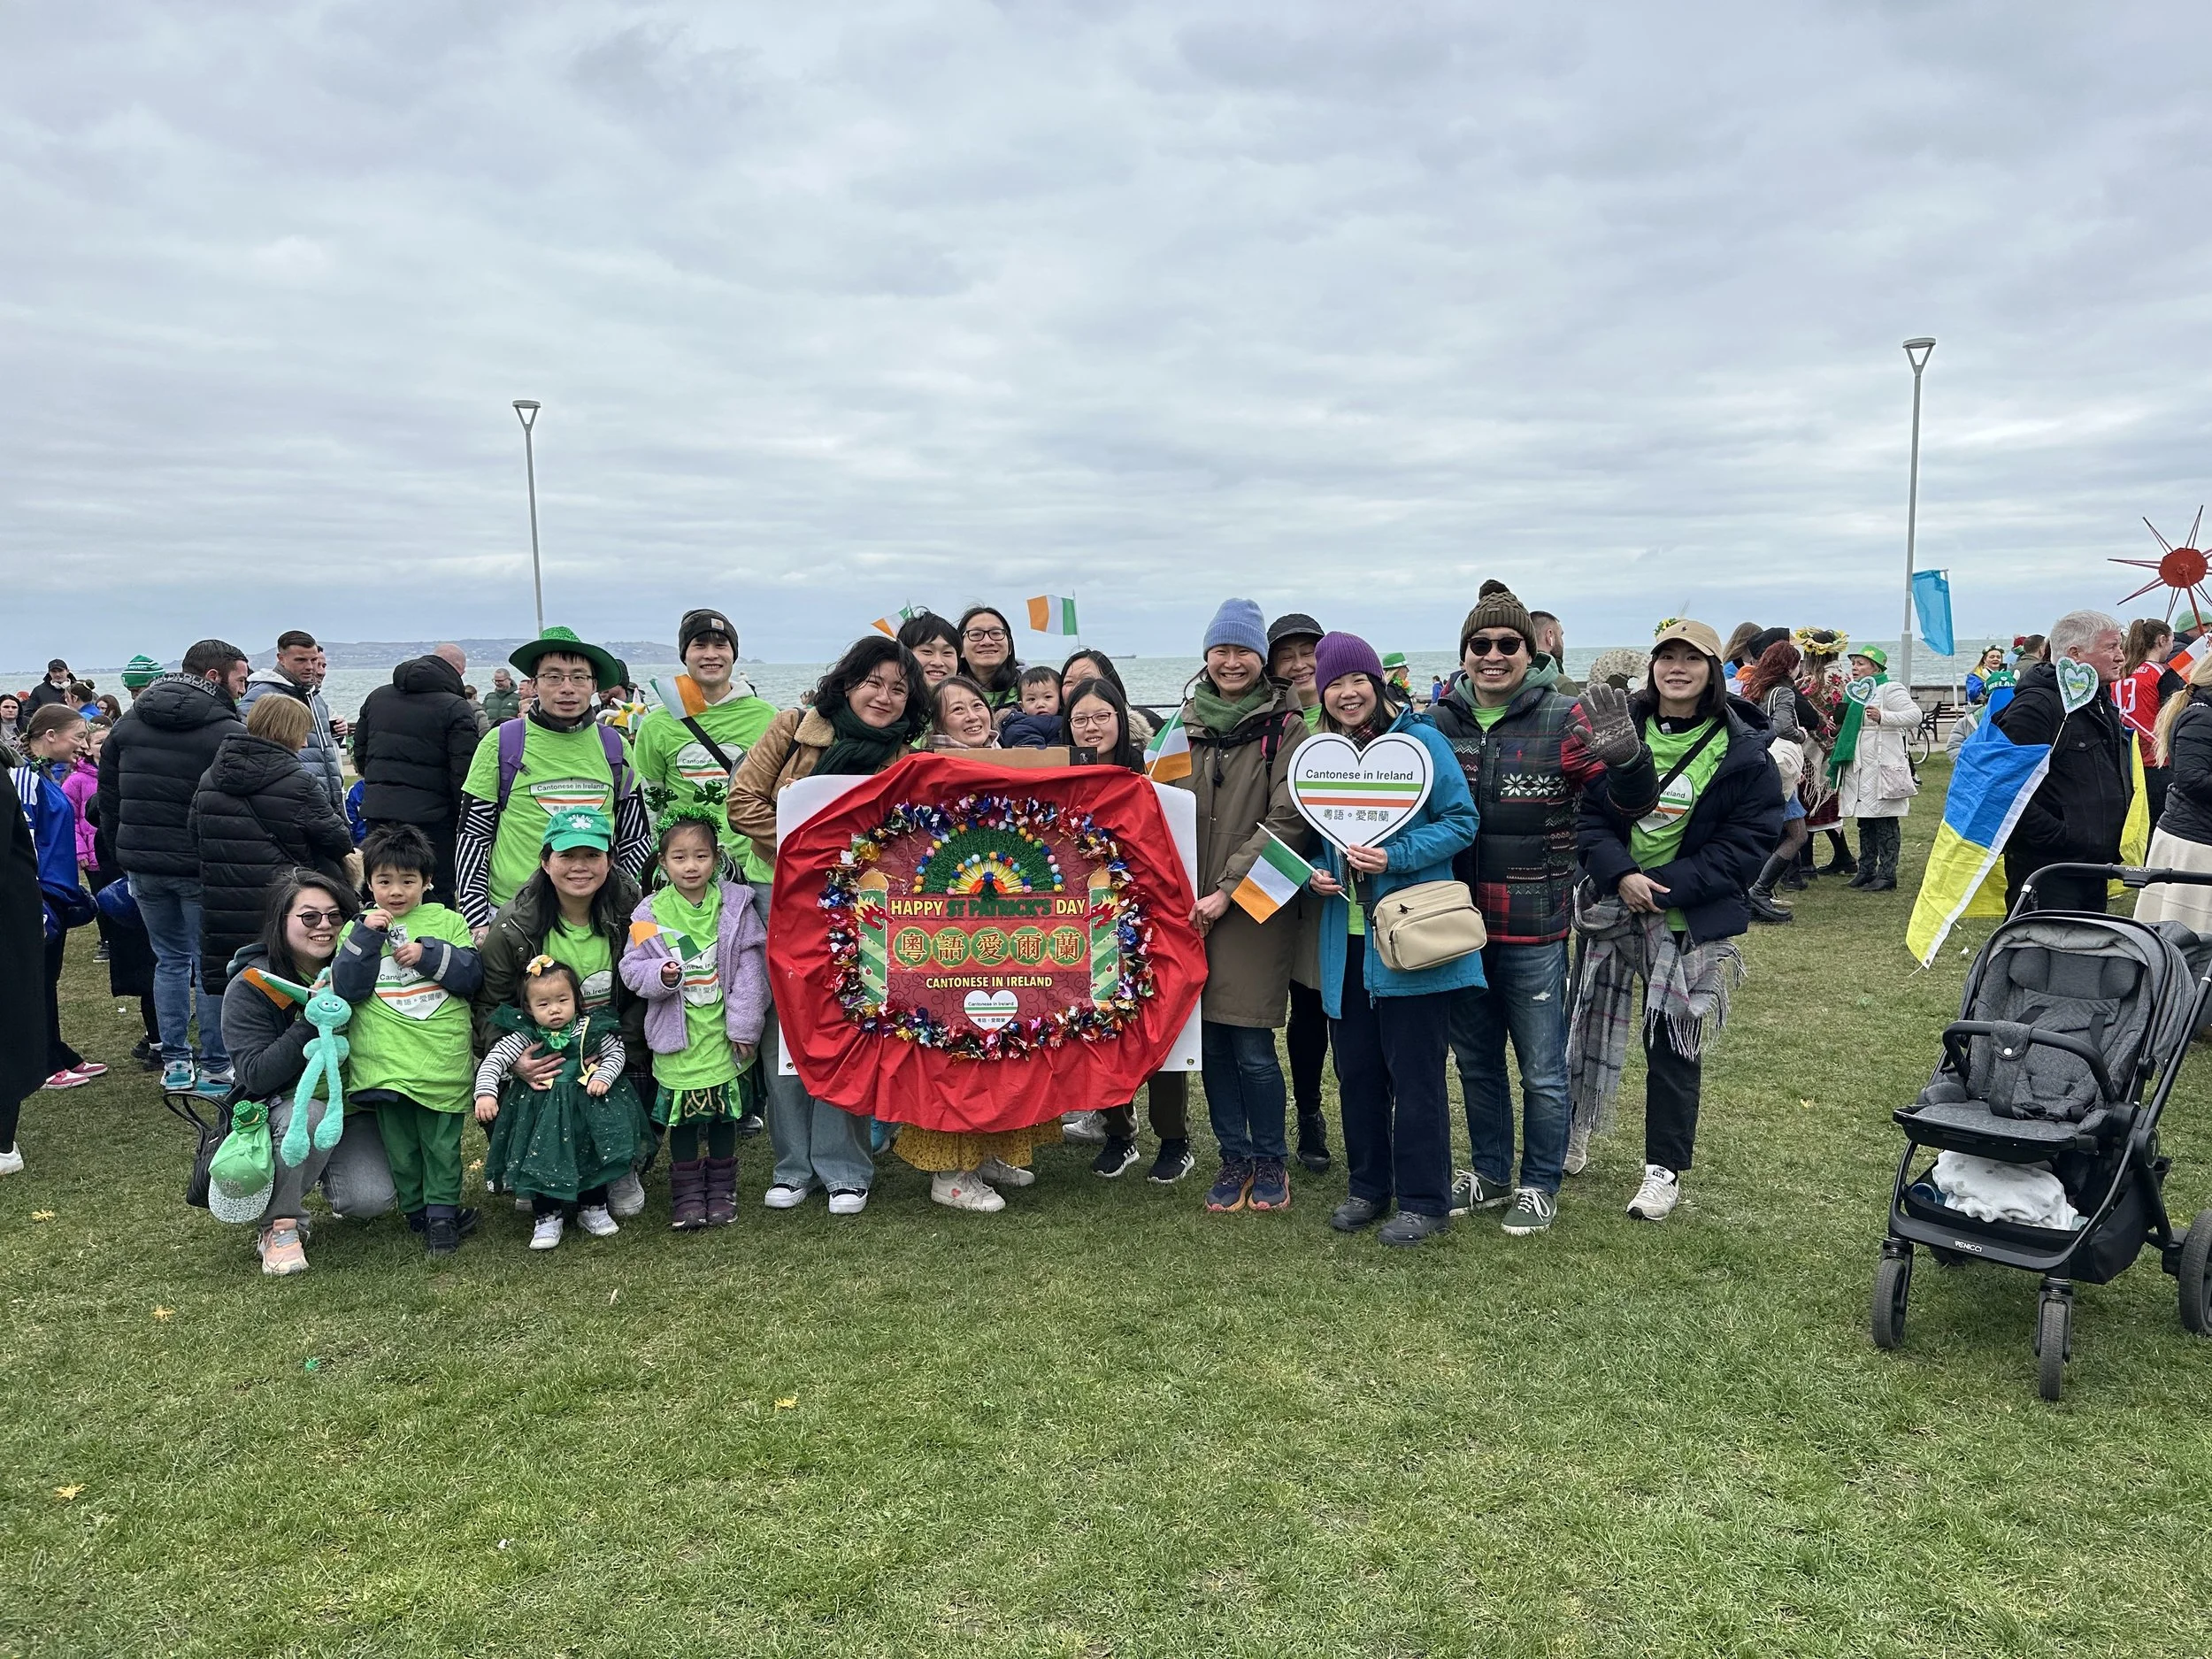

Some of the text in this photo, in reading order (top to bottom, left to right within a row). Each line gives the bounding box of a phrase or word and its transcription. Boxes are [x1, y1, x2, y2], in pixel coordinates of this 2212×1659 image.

[1306, 769, 1414, 780] Cantonese in Ireland
[537, 783, 574, 792] Cantonese
[566, 814, 594, 824] IRELAND
[890, 899, 944, 917] HAPPY
[946, 899, 966, 917] ST
[1056, 898, 1087, 916] DAY
[898, 931, 1080, 962] 粵語愛爾蘭
[926, 976, 1053, 989] CANTONESE IN IRELAND
